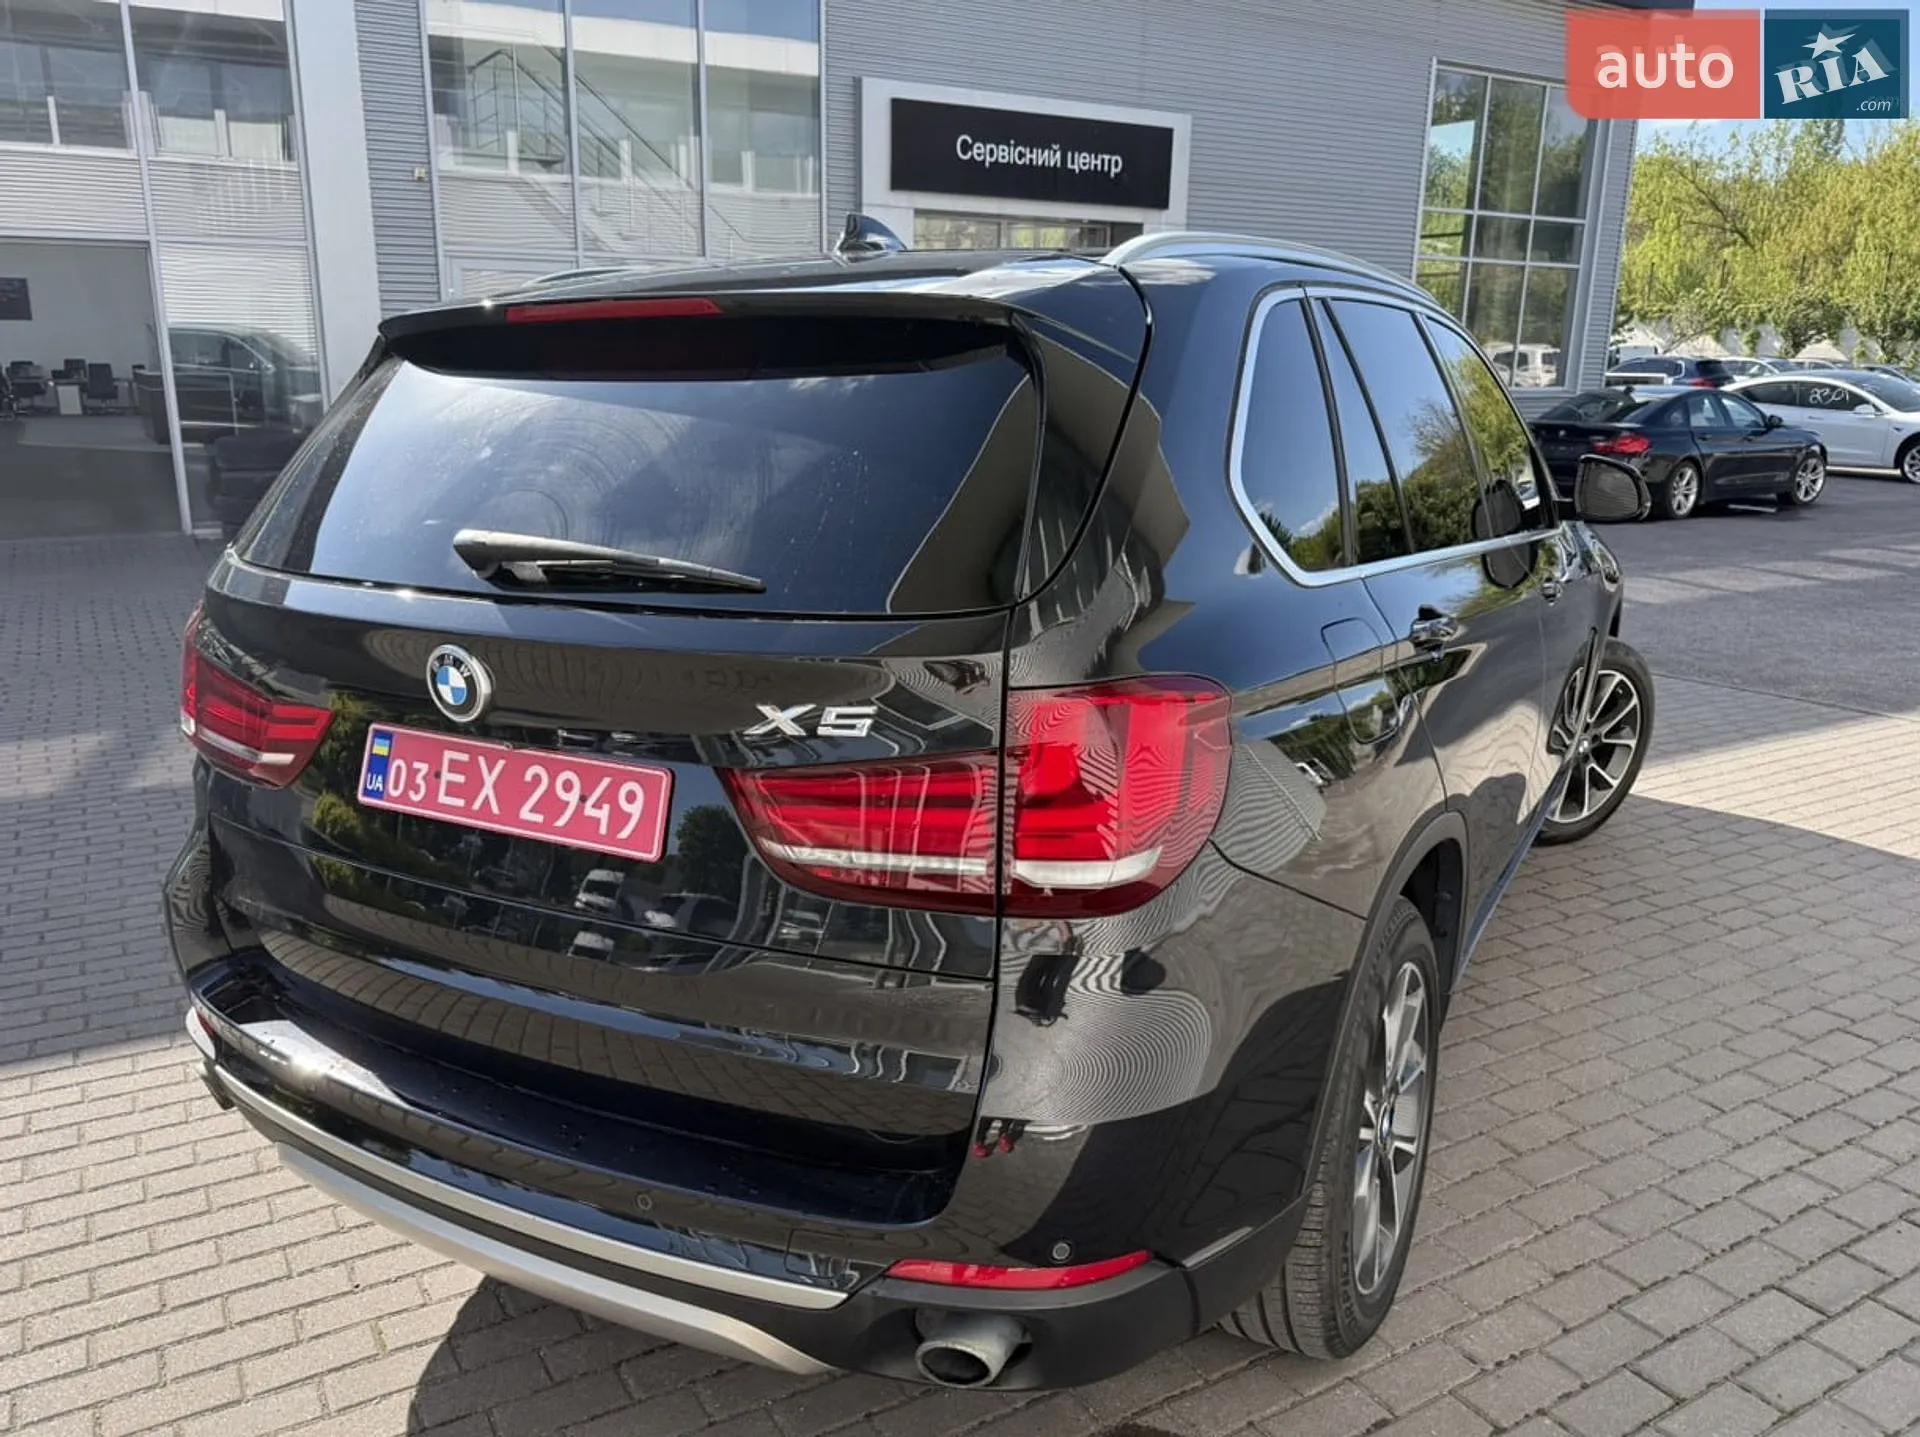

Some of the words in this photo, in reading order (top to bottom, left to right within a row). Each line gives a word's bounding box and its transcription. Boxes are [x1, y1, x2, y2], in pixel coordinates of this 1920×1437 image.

[956, 134, 1061, 168] Сервісний
[1067, 149, 1123, 178] центр
[743, 703, 878, 737] X5
[366, 773, 384, 792] UA
[519, 764, 645, 840] 2949
